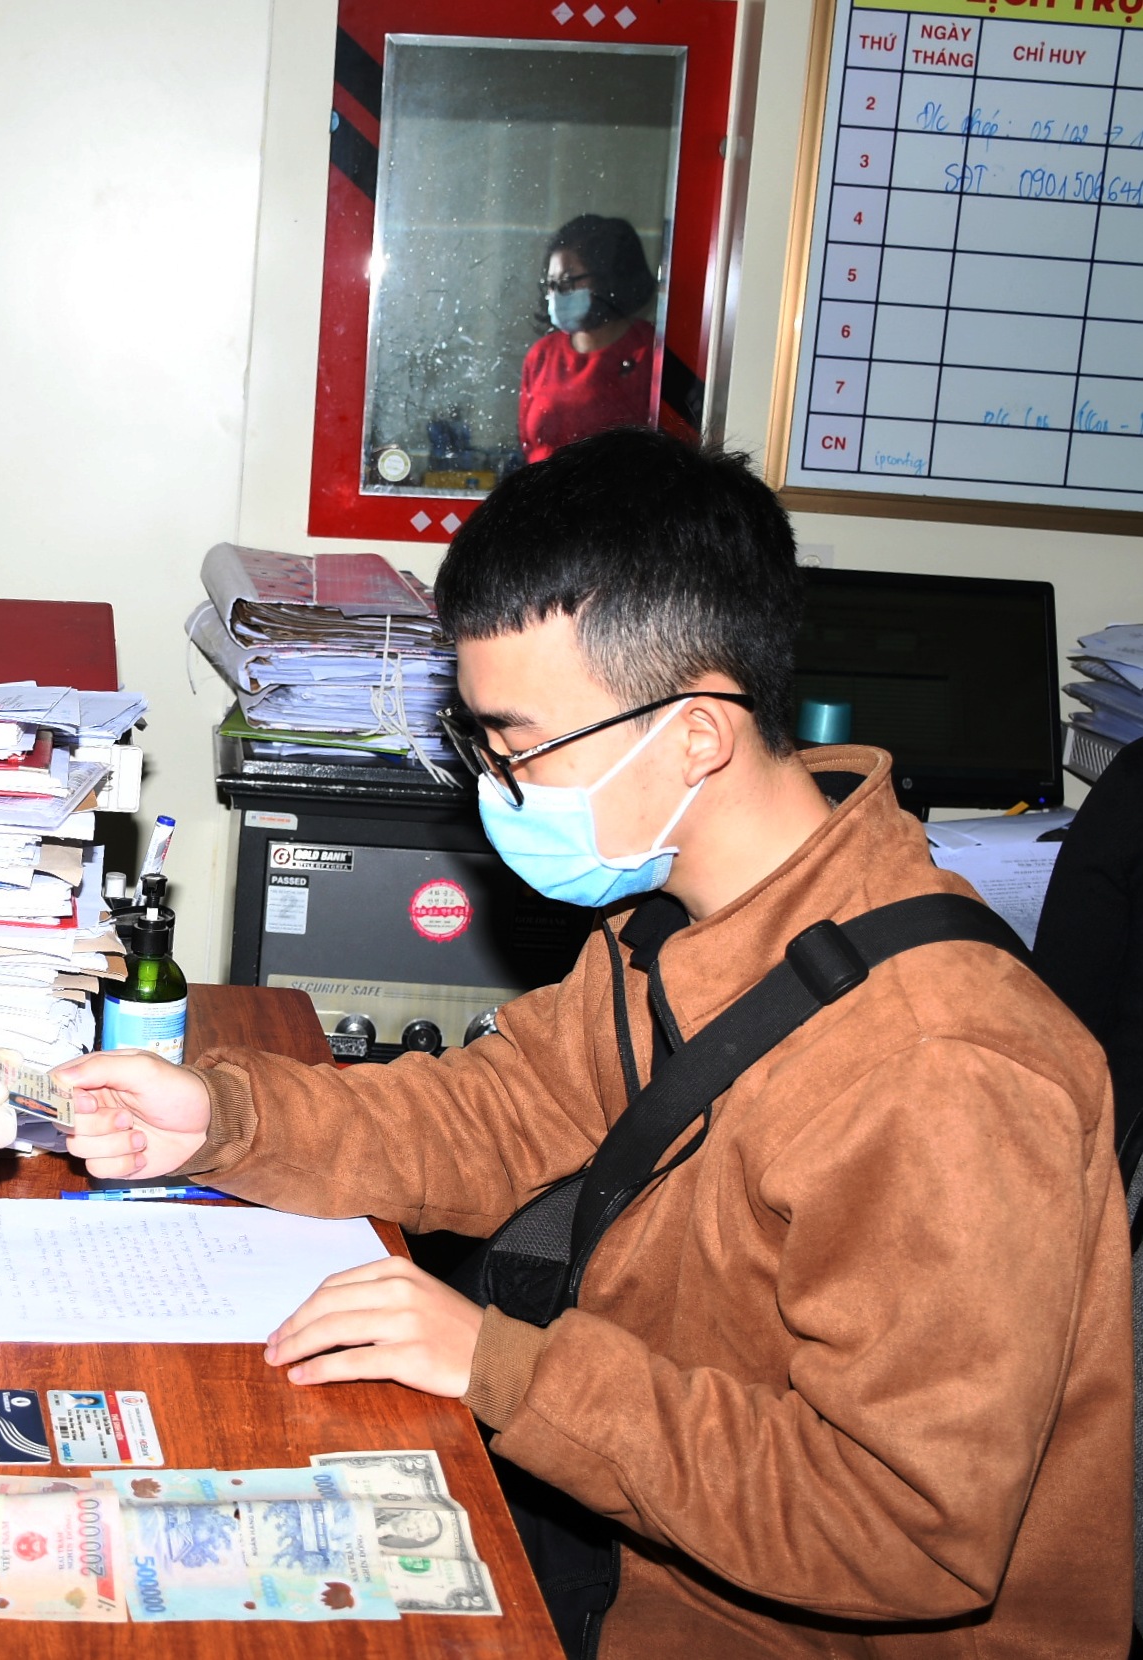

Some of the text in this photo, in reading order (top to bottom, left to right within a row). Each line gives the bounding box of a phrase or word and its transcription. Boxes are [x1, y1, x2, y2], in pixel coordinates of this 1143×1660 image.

[920, 24, 972, 42] NGÀY
[859, 32, 897, 51] THỨ
[912, 46, 974, 68] THÁNG
[1012, 41, 1087, 65] CHỈ HUY
[865, 96, 876, 111] 2
[859, 154, 870, 169] 3
[853, 211, 864, 226] 4
[847, 269, 857, 282] 5
[841, 325, 851, 338] 6
[835, 381, 846, 394] 7
[821, 435, 847, 451] CN
[320, 850, 348, 862] BANK
[271, 875, 307, 886] PASSED
[290, 981, 382, 997] SECURITY SAFE
[133, 1555, 166, 1614] 500000
